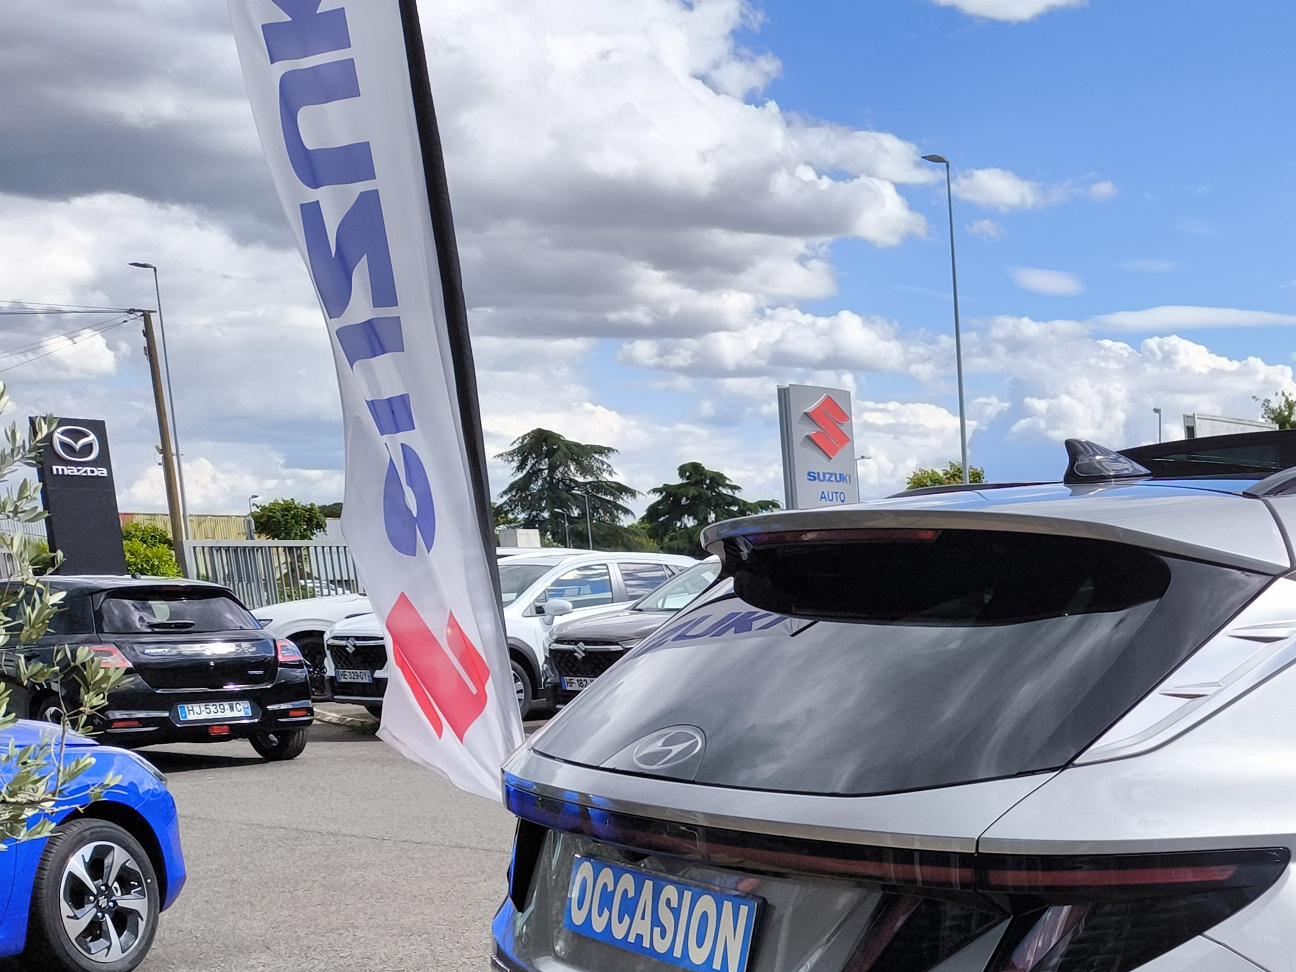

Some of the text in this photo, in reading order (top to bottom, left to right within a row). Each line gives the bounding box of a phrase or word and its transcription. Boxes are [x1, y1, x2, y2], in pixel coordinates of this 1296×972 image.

[52, 465, 108, 477] mazda
[806, 471, 852, 484] SUZUKI
[819, 491, 847, 503] AUTO
